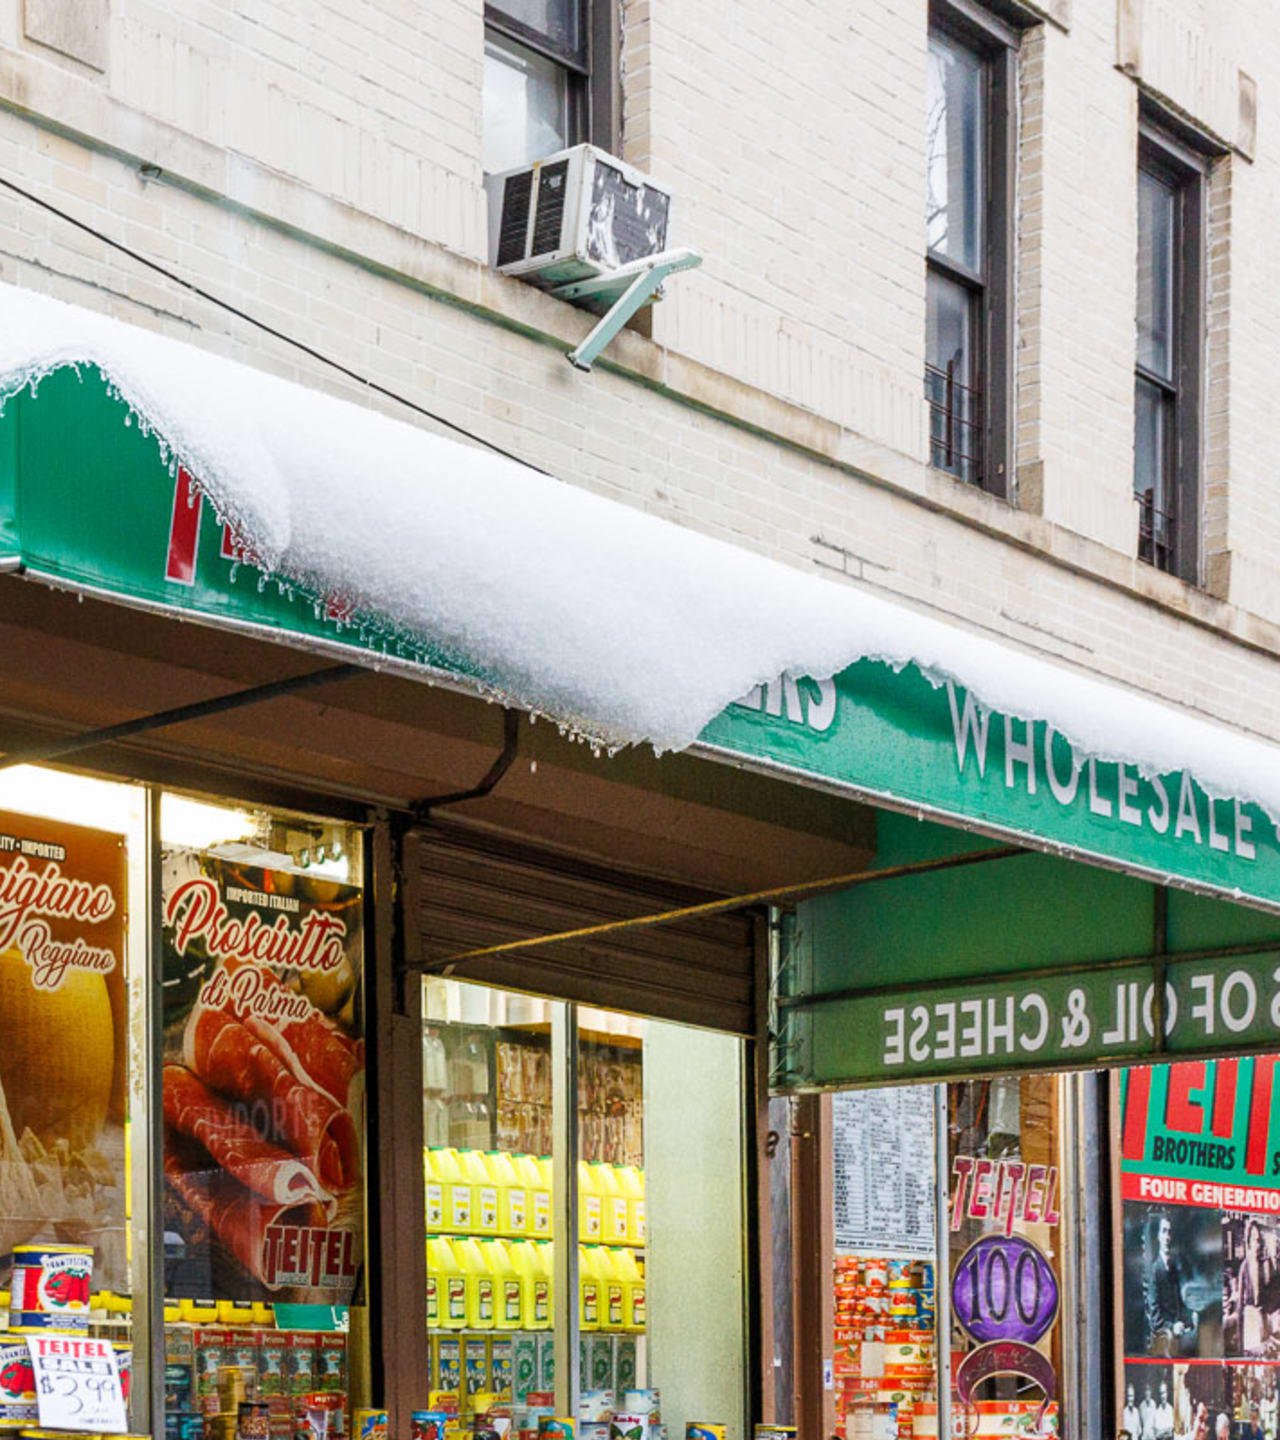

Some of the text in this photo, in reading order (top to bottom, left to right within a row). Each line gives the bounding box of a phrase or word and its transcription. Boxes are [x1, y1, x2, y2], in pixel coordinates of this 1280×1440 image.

[21, 839, 66, 860] IMPORTED
[167, 880, 346, 973] Prosciutto
[226, 887, 300, 912] IMPORTED ITALIAN
[19, 921, 116, 990] Reggiano
[200, 967, 310, 1022] di Parma
[1152, 1135, 1236, 1171] BROTHERS
[950, 1155, 1061, 1238] TEITEL
[1140, 1177, 1188, 1200] FOUR
[264, 1225, 356, 1288] TEITEL
[966, 1246, 1042, 1327] 100
[36, 1338, 109, 1359] TEITEL
